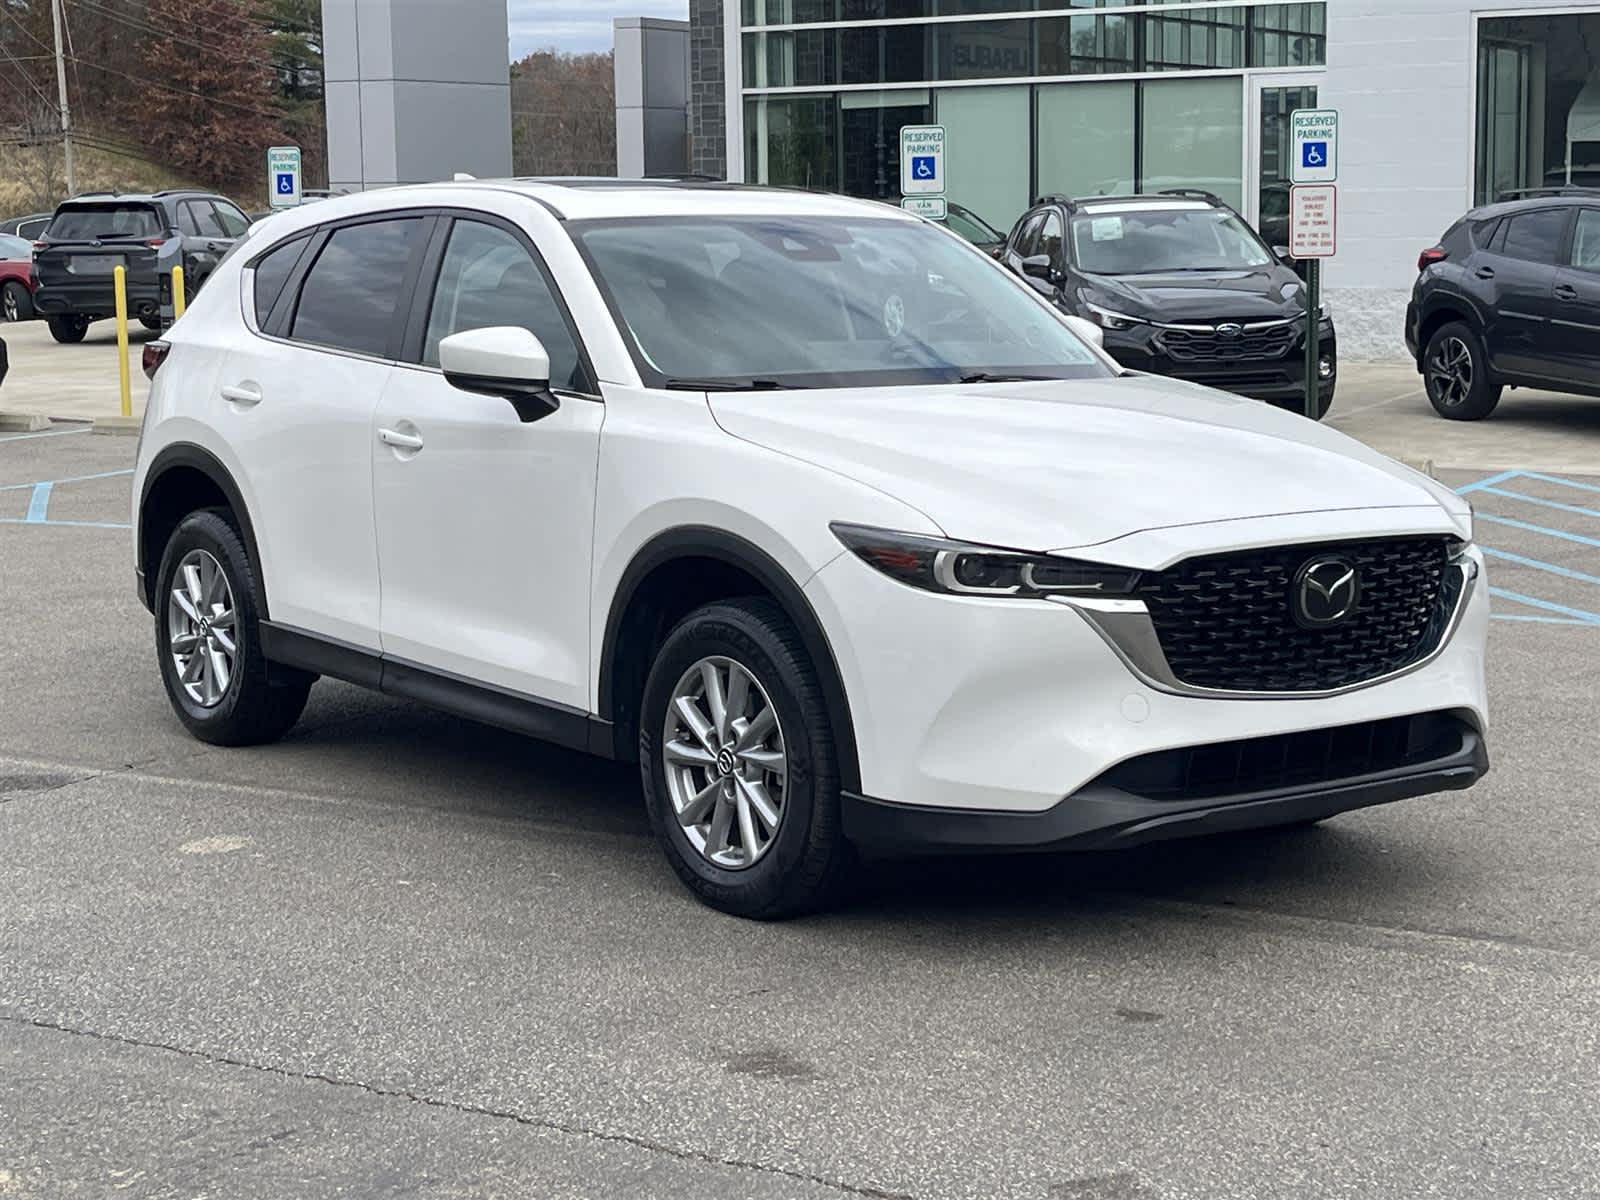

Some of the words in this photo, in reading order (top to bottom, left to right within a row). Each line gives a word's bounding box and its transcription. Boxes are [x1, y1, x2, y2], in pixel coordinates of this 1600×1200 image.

[1295, 115, 1336, 126] RESERVED
[904, 132, 943, 142] RESERVED
[1297, 129, 1332, 139] PARKING
[906, 144, 941, 153] PARKING
